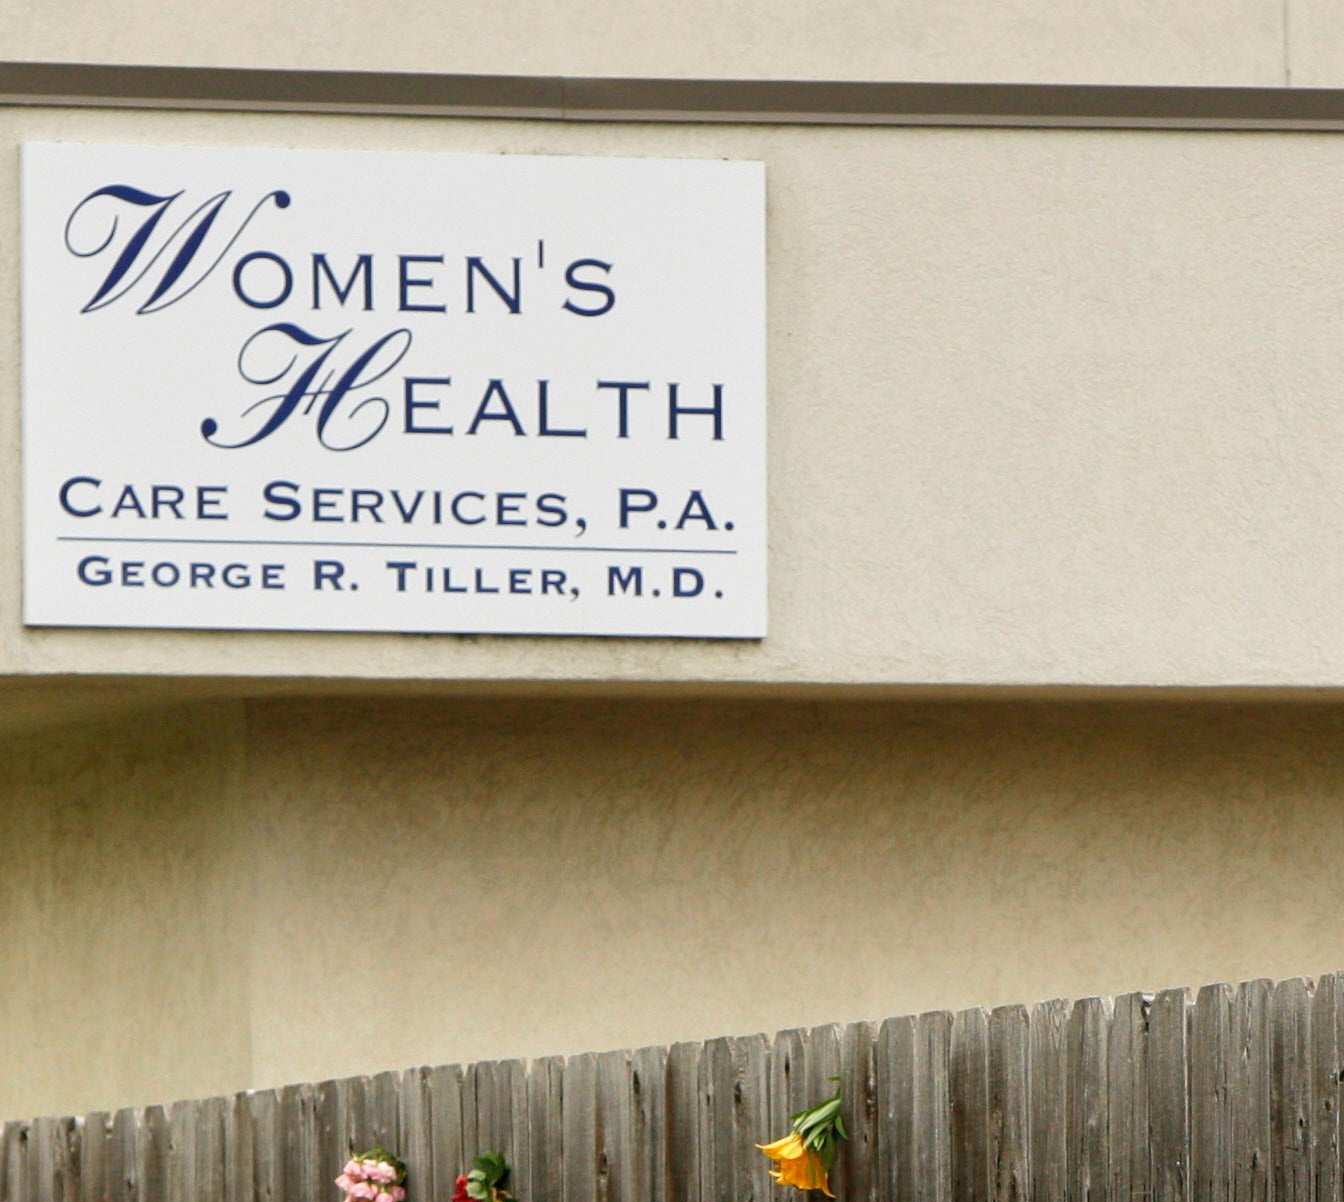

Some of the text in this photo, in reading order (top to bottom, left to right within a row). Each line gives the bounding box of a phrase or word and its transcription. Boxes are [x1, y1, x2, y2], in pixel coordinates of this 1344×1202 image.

[65, 184, 616, 318] WOMEN'S
[200, 322, 725, 452] HEALTH
[58, 475, 735, 538] CARE SERVICES, P.A.
[76, 555, 724, 600] GEORGE R. TILLER, M.D.
